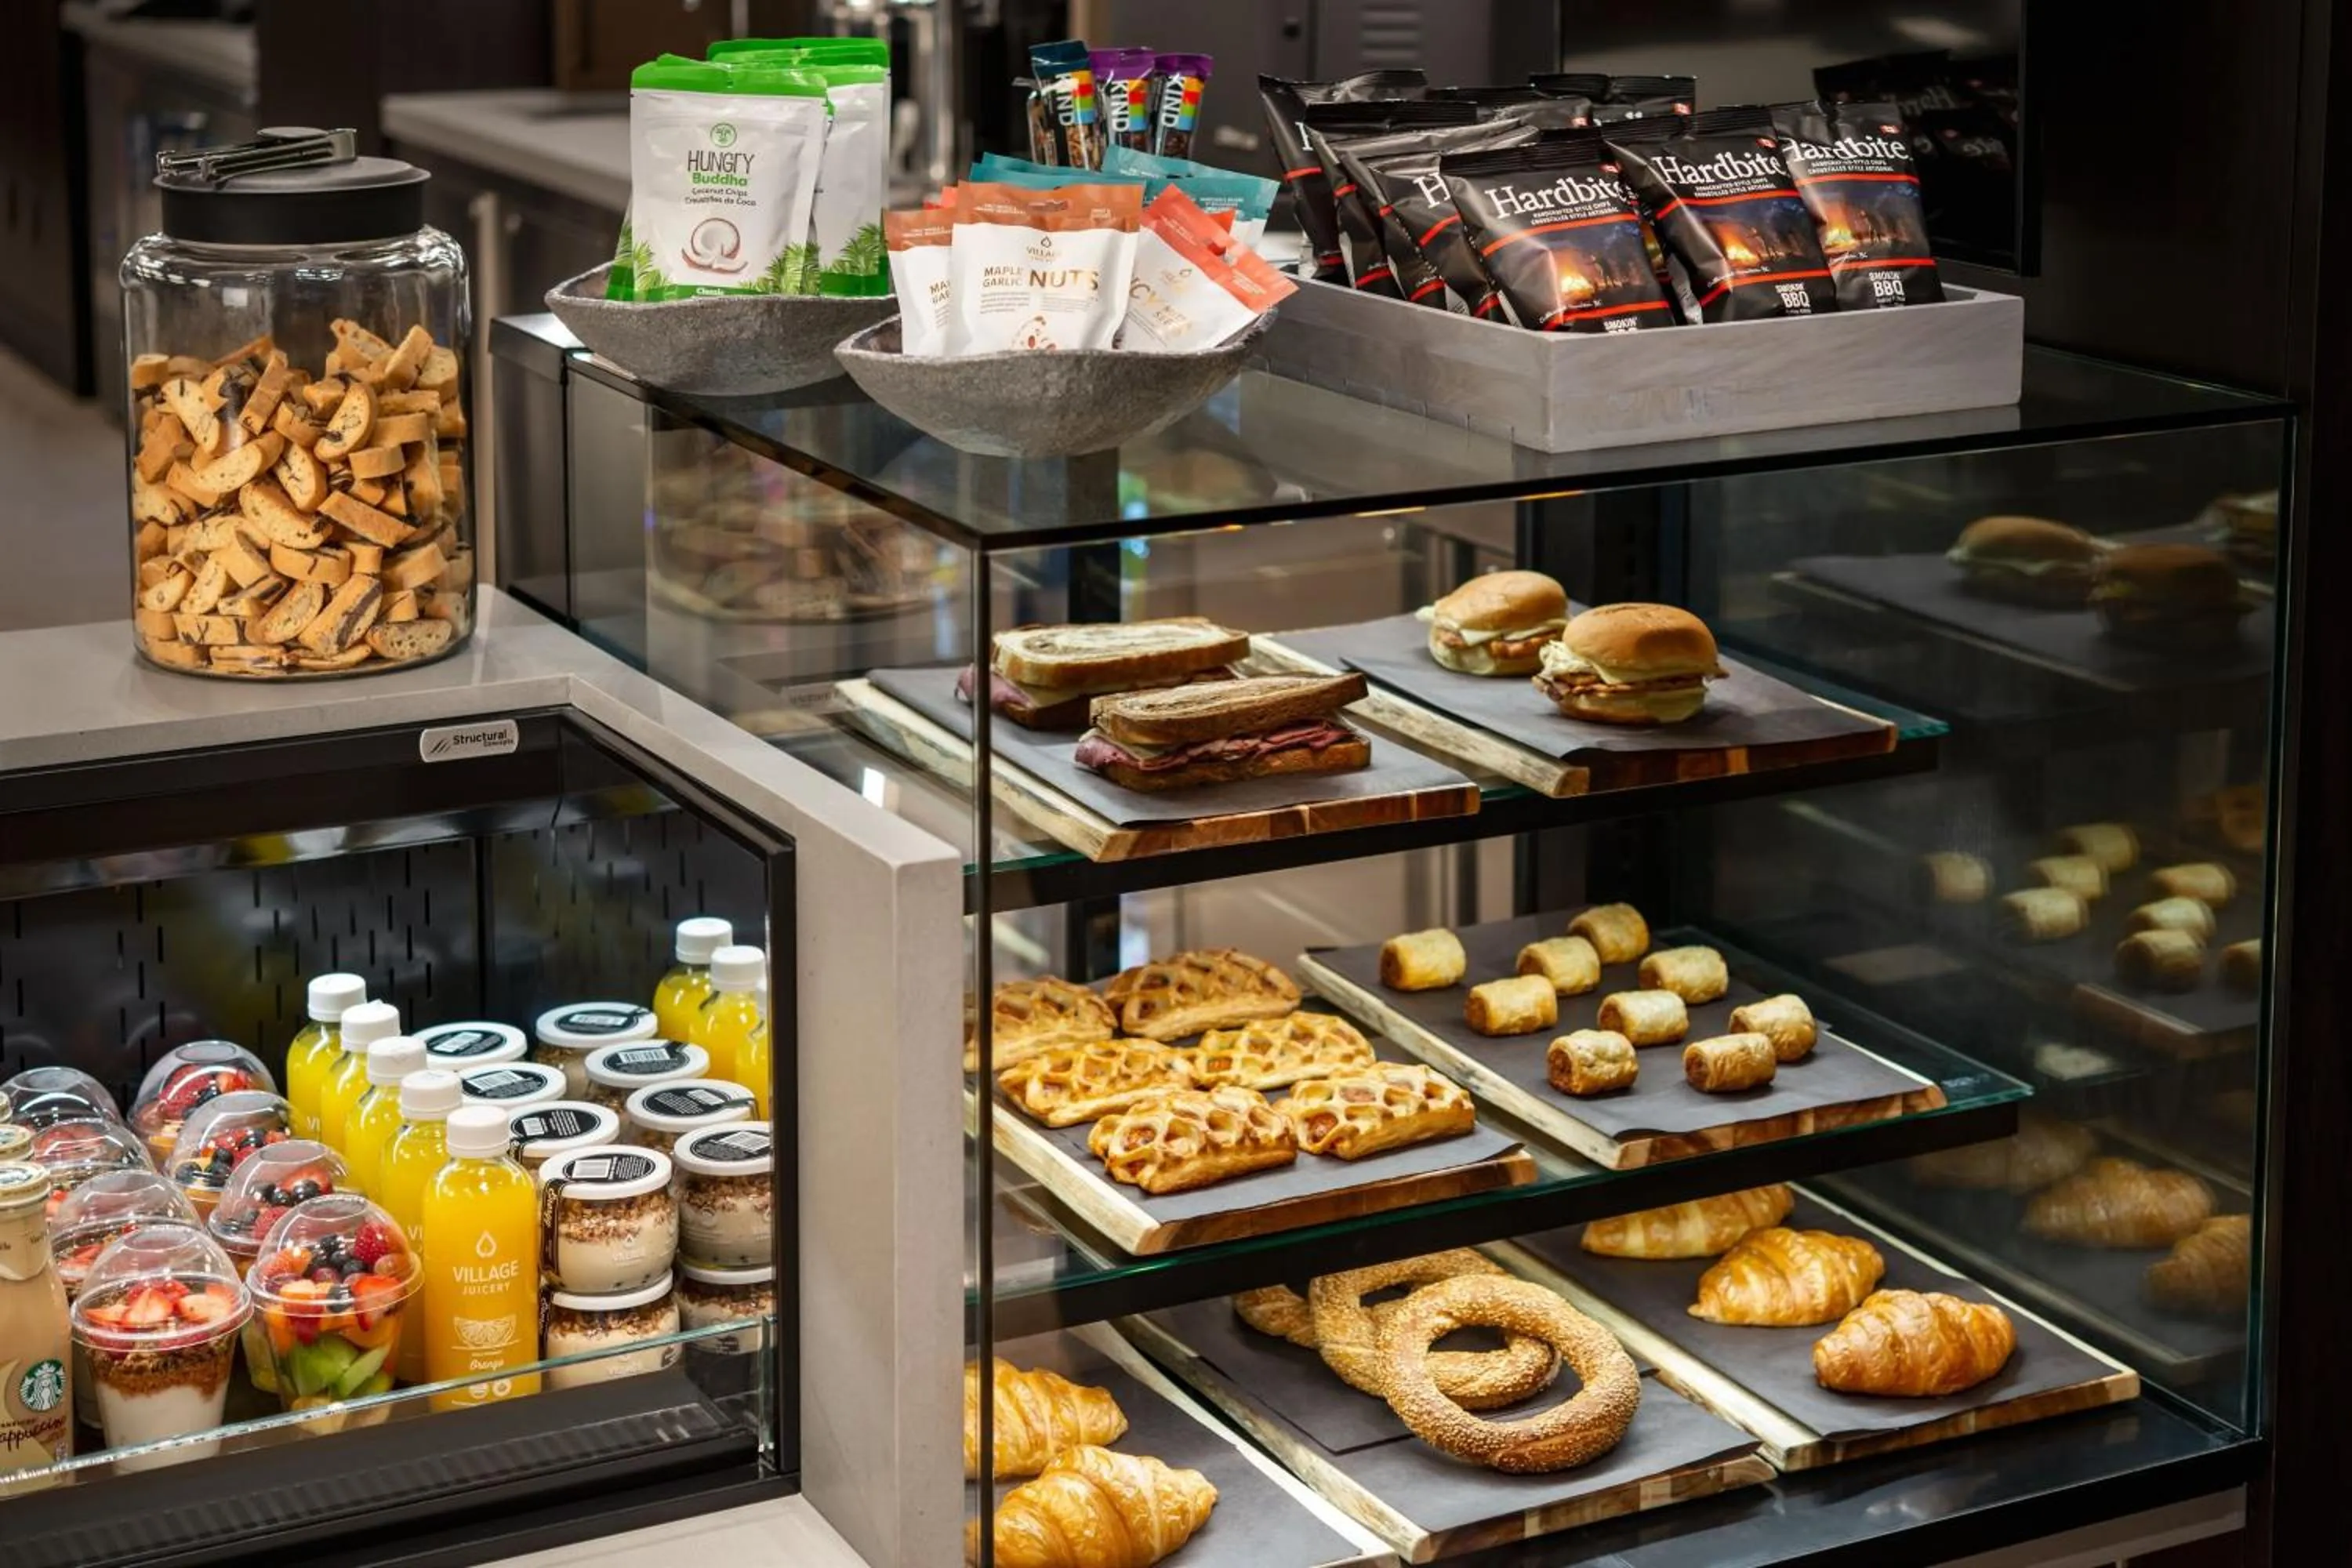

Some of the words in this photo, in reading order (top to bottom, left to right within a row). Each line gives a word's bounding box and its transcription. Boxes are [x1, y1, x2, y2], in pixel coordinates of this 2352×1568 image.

[1110, 79, 1130, 132] KIND
[1161, 74, 1186, 127] KIND
[1651, 151, 1788, 185] Hardbite
[692, 172, 748, 187] Buddha
[1484, 176, 1628, 220] Hardbite
[1026, 246, 1061, 257] VILLA
[982, 278, 1023, 288] GARLIC
[1029, 269, 1099, 291] NUTS
[1873, 280, 1905, 297] BBQ
[1781, 291, 1811, 308] BBQ
[453, 729, 507, 746] Structural
[452, 1259, 520, 1283] VILLAGE
[462, 1282, 510, 1295] JUICERY
